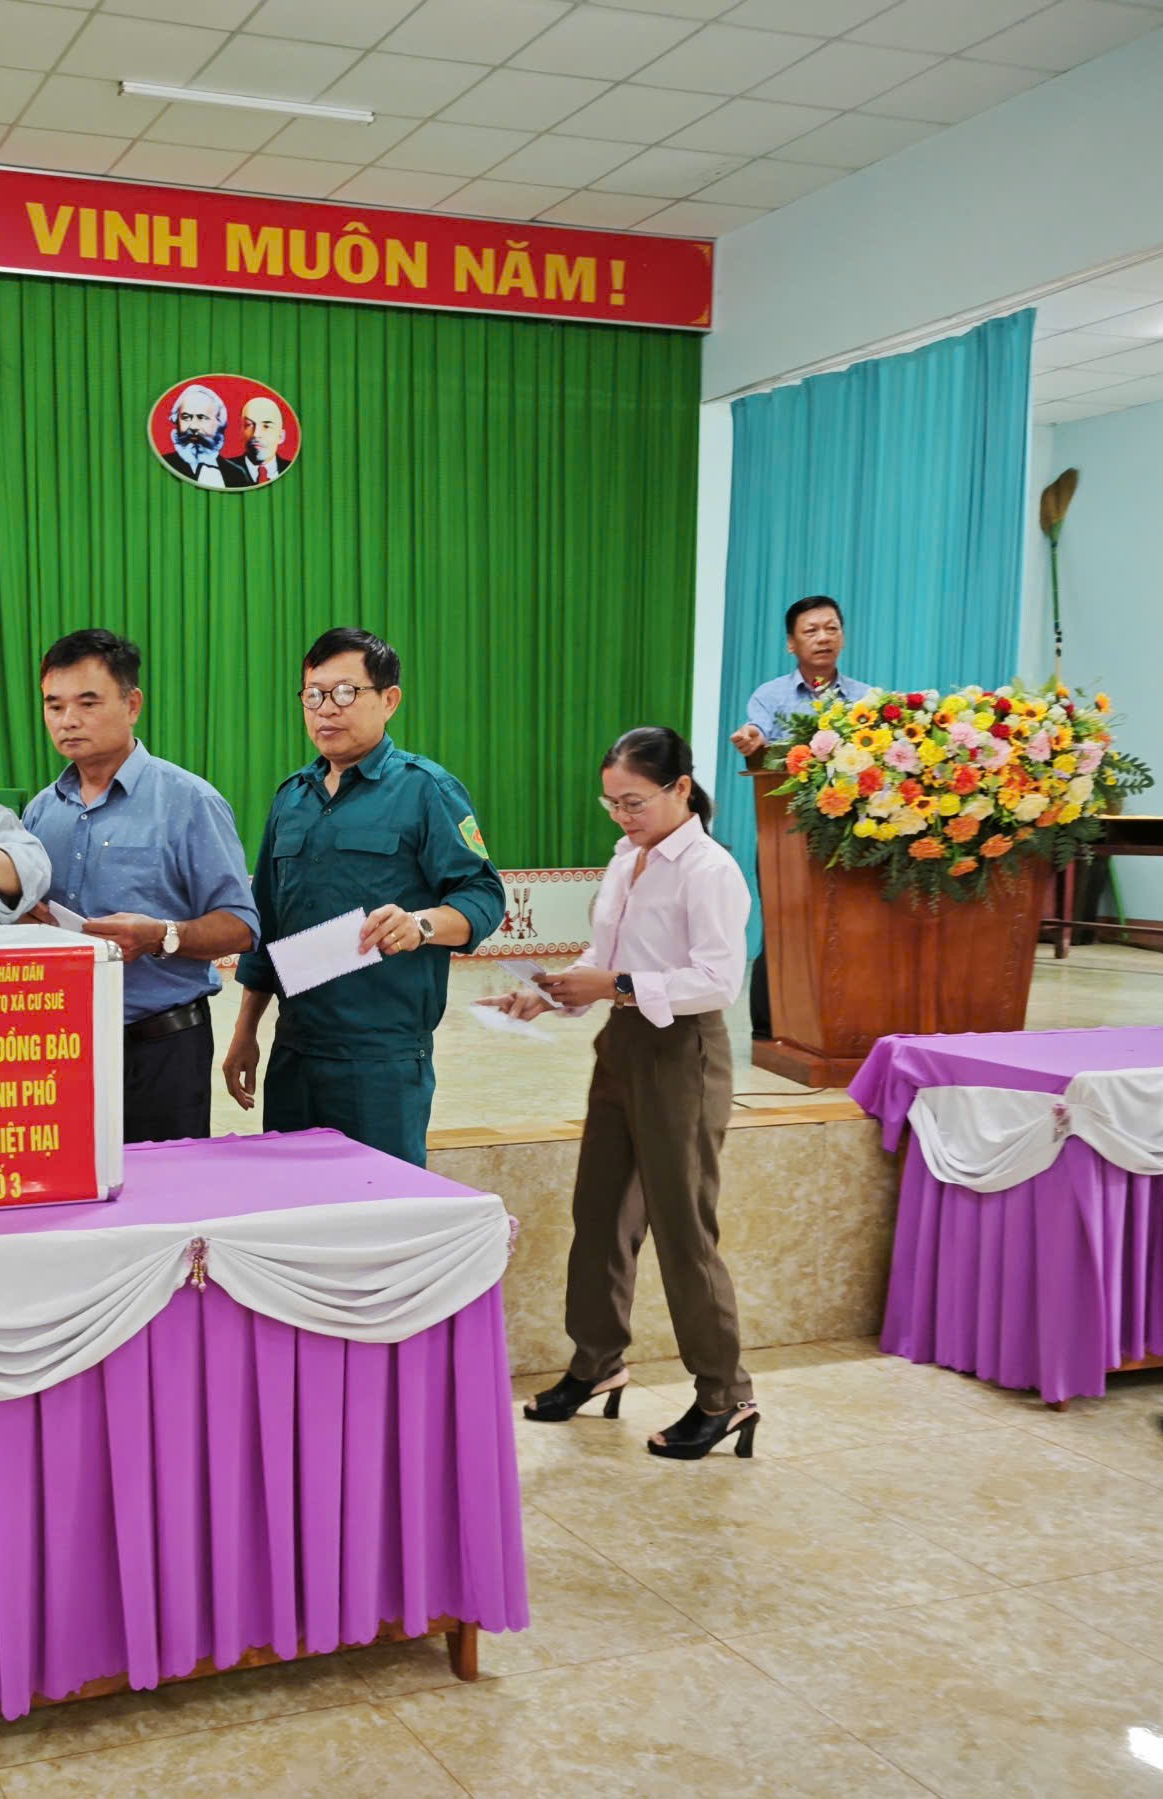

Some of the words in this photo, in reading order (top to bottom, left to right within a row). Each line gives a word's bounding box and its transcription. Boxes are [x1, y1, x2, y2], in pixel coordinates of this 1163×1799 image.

[25, 202, 199, 269] VINH
[226, 221, 428, 289] MUÔN
[22, 961, 45, 981] DÂN
[11, 990, 26, 1011] XÃ
[27, 991, 44, 1011] CƯ
[44, 988, 66, 1010] SUÊ
[45, 1027, 81, 1061] BÀO
[21, 1068, 58, 1107] PHỐ
[29, 1123, 61, 1157] HẠI
[10, 1171, 23, 1199] 3
